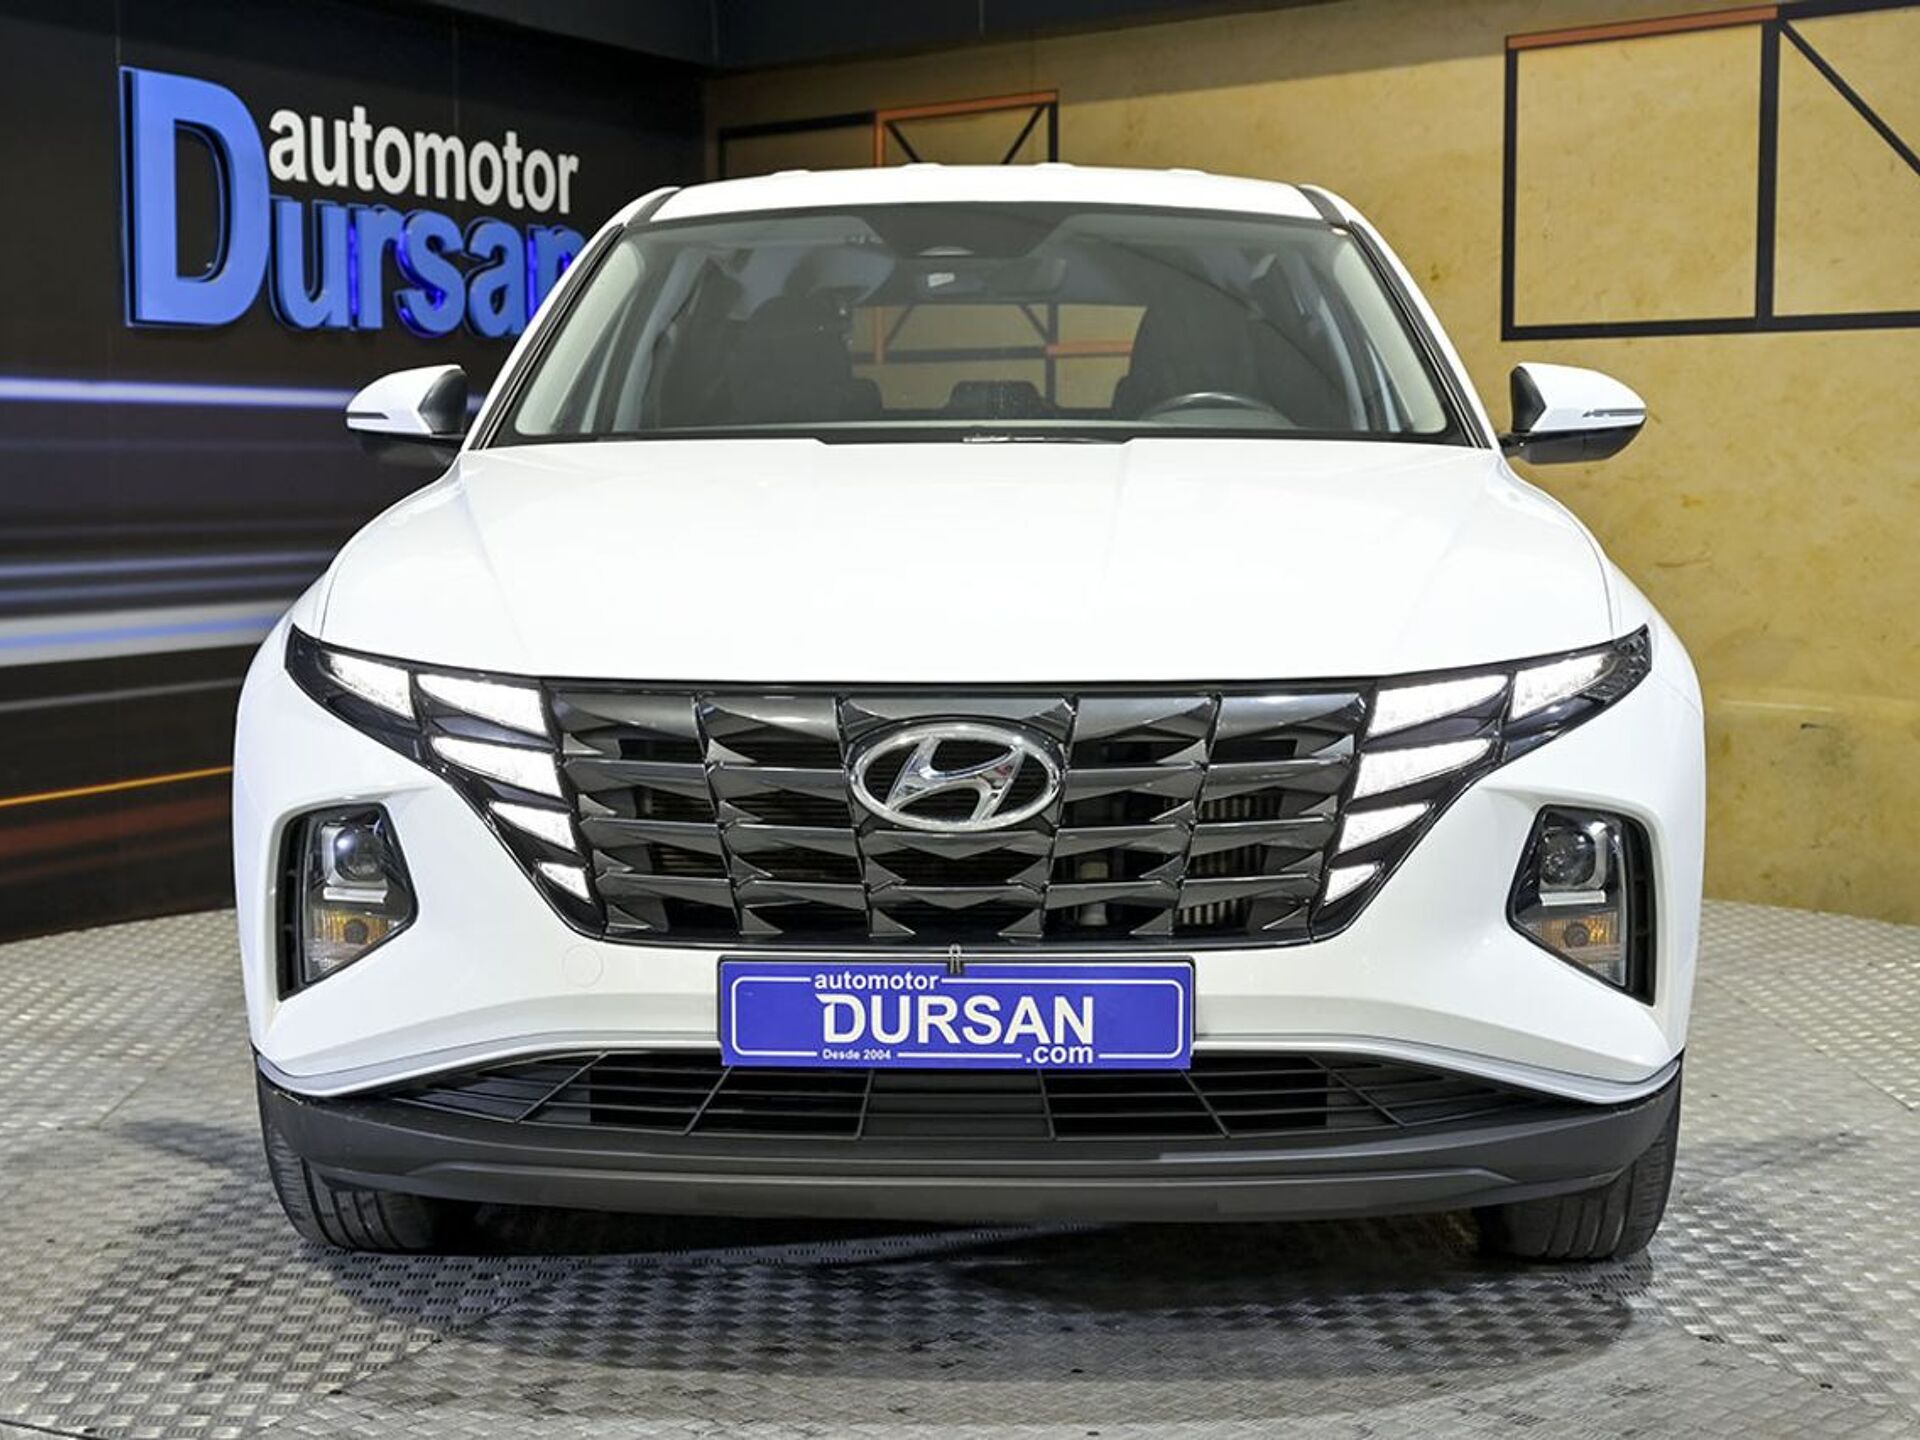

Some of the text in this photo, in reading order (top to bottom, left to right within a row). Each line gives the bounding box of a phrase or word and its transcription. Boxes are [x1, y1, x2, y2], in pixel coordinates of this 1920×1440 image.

[268, 105, 580, 215] automotor
[814, 971, 939, 991] automotor
[814, 993, 1094, 1045] DURSAN
[822, 1048, 892, 1061] Desde 2004
[1026, 1043, 1094, 1064] .com
